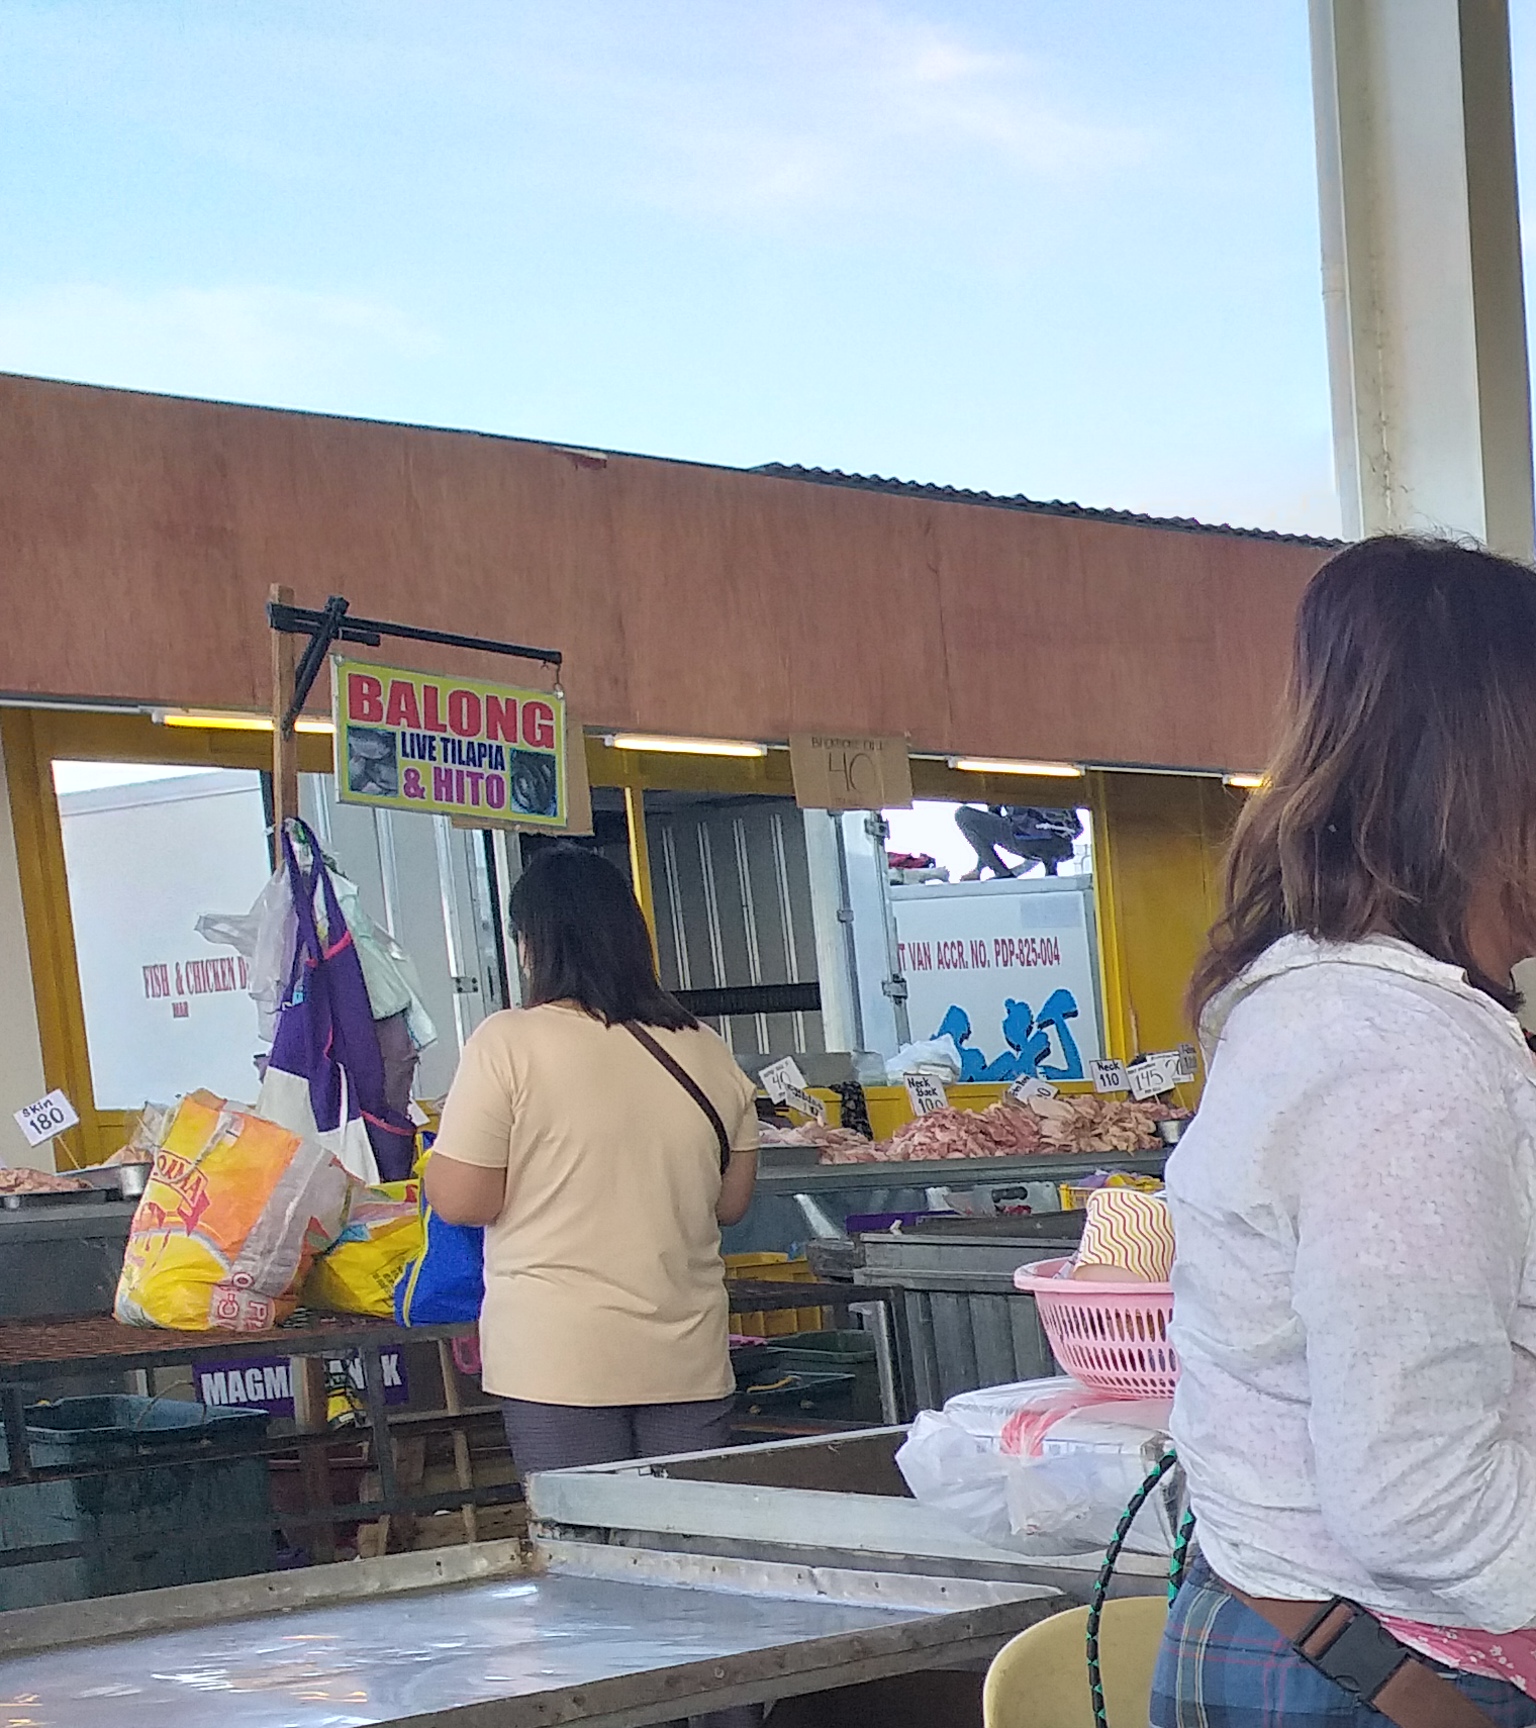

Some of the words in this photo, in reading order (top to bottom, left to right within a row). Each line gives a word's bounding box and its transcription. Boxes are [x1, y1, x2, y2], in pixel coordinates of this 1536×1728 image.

[347, 673, 555, 749] BALONG
[400, 731, 437, 762] LIVE
[439, 737, 506, 771] TILAPIA
[403, 767, 427, 800] &
[433, 766, 507, 809] HITO
[908, 942, 932, 972] VAN
[937, 940, 969, 969] ACCR.
[970, 940, 990, 968] NO.
[994, 936, 1061, 968] PDP-825-004
[142, 963, 171, 999] FISH
[175, 961, 185, 995] &
[185, 956, 237, 995] CHICKEN
[907, 1077, 930, 1088] Neck
[1100, 1072, 1120, 1087] 110
[1136, 1069, 1164, 1091] 145
[29, 1107, 65, 1135] 180
